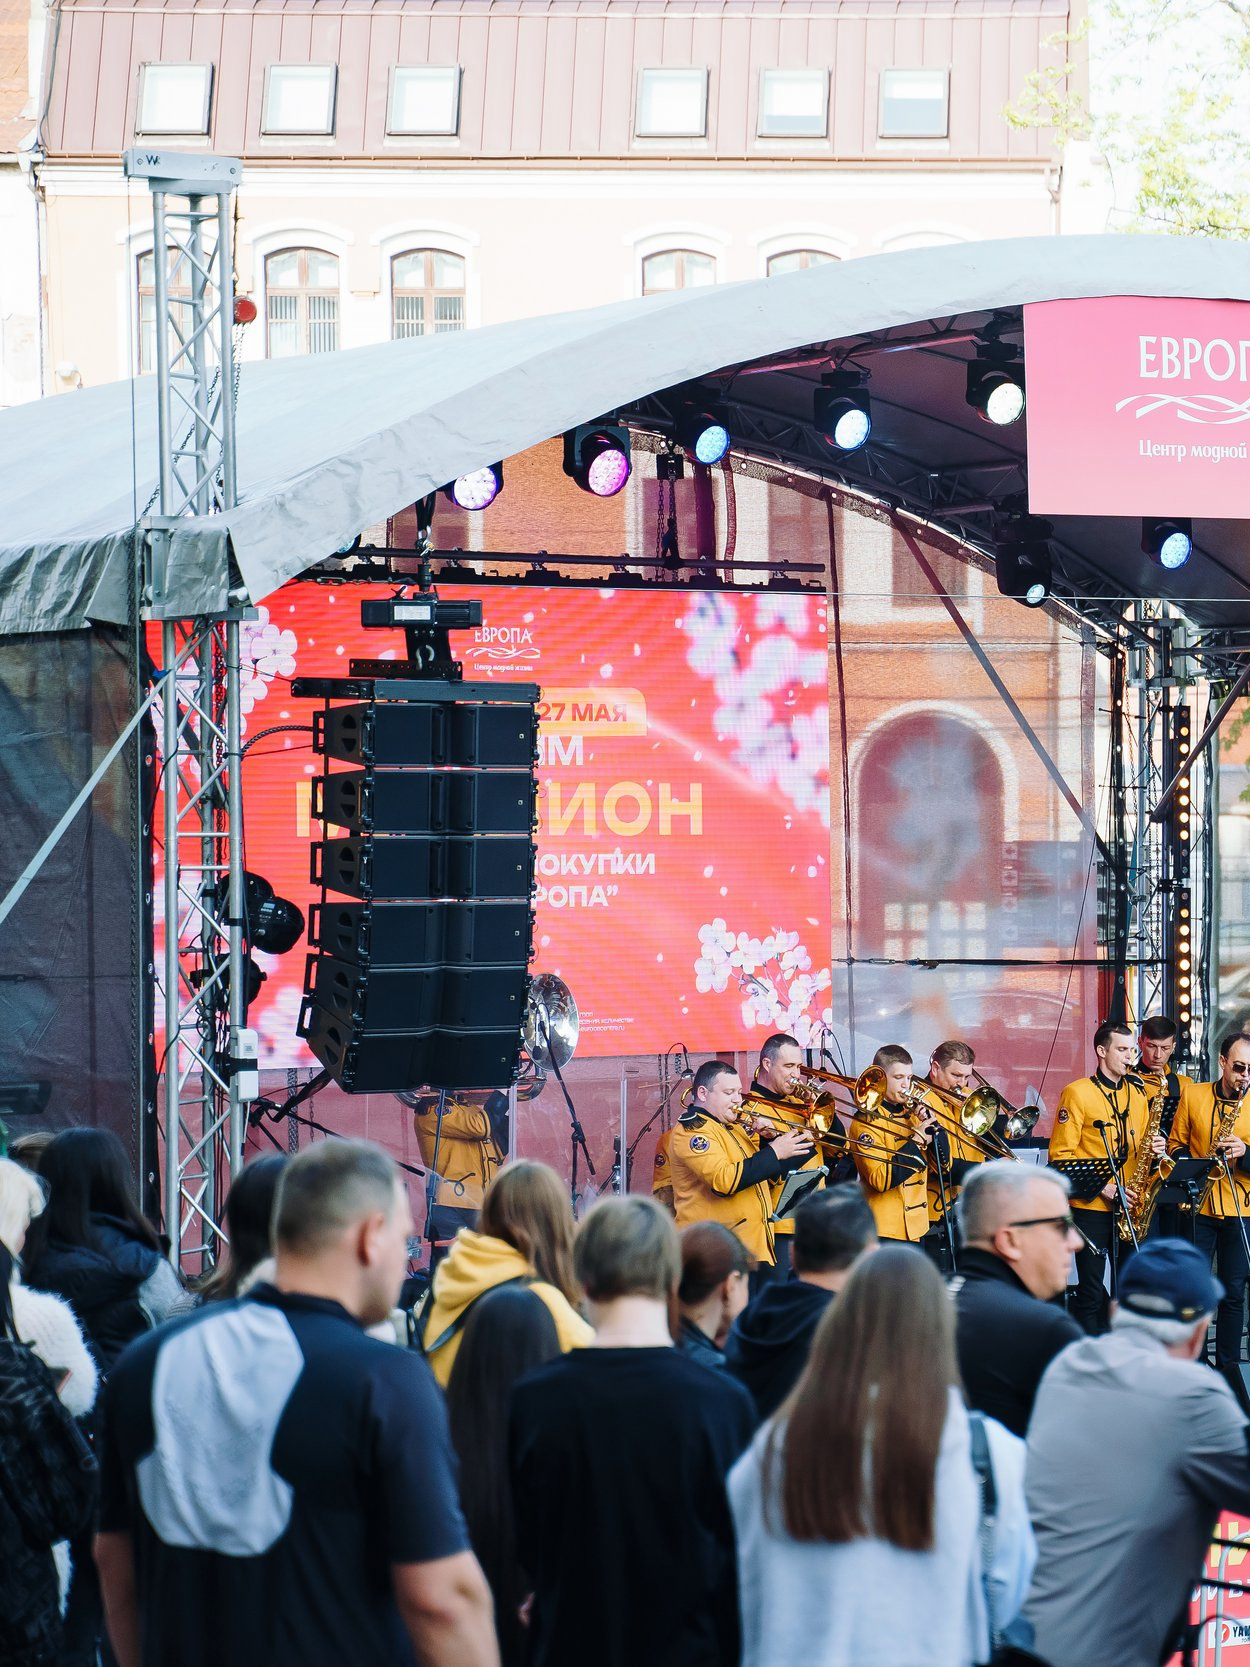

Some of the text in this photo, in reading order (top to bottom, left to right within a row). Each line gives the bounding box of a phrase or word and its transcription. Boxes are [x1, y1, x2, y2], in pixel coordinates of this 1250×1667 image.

[1139, 440, 1187, 462] Центр
[1190, 442, 1248, 463] модной
[474, 626, 533, 644] ЕВРОПА
[571, 703, 627, 722] МАЯ
